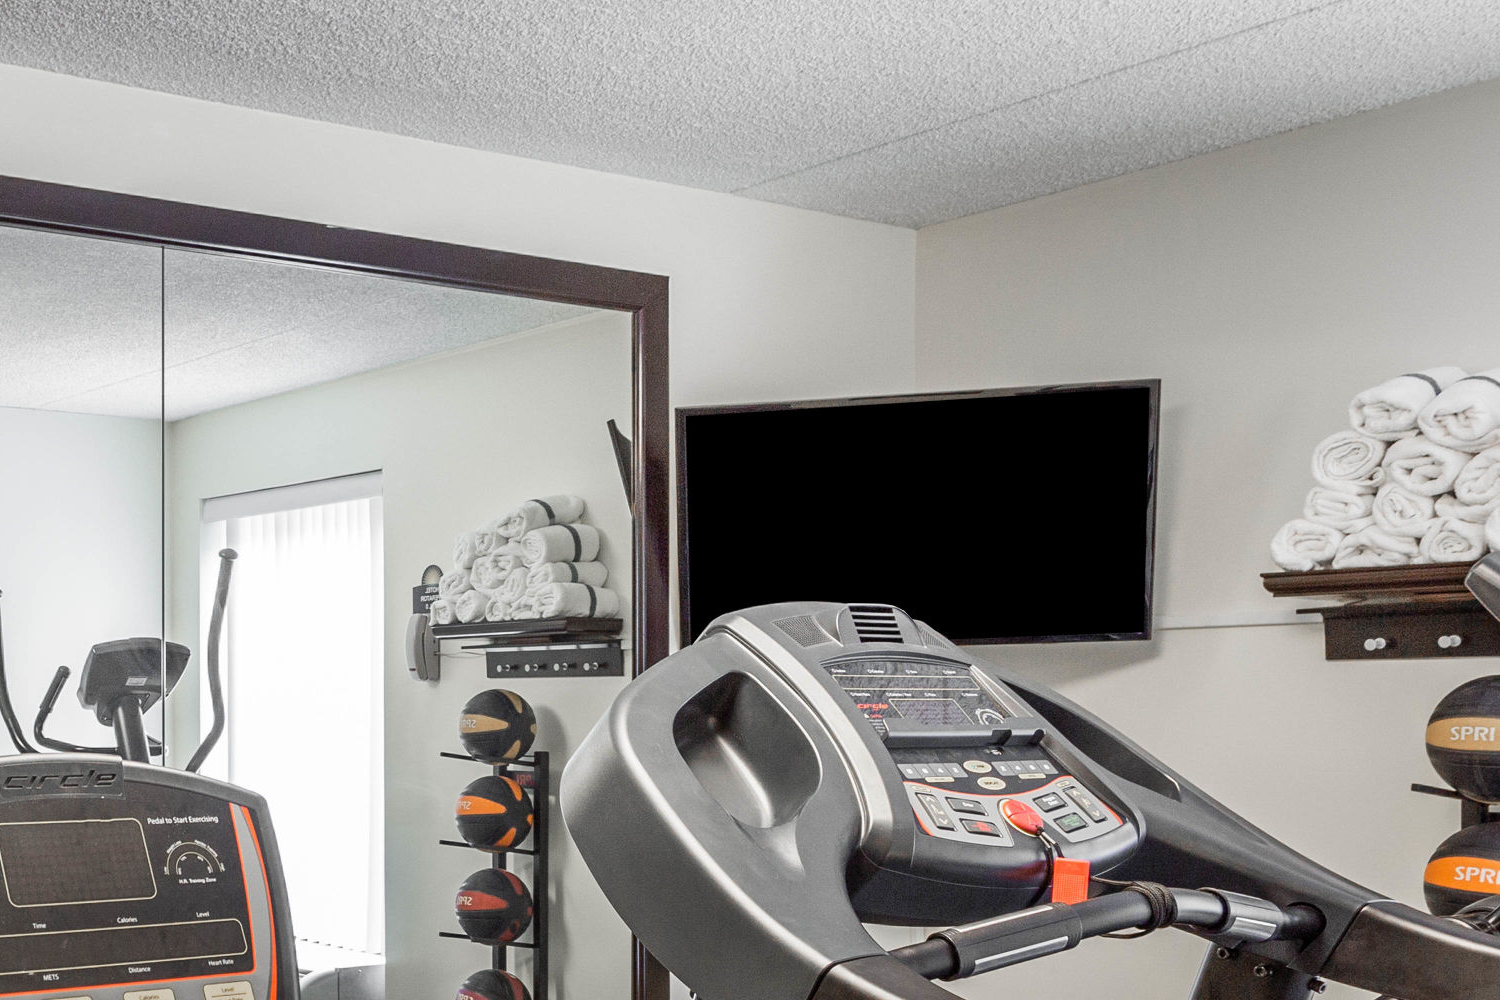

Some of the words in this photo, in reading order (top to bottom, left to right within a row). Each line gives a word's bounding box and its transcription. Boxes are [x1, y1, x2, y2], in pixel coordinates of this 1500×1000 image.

[1450, 726, 1496, 742] SPRI
[3, 769, 117, 790] circle
[147, 817, 165, 825] Pedal
[173, 816, 188, 824] Start
[188, 815, 219, 824] Exercising
[116, 916, 138, 924] Calories
[208, 959, 223, 967] Heart
[128, 966, 151, 974] Distance
[42, 973, 60, 981] METS
